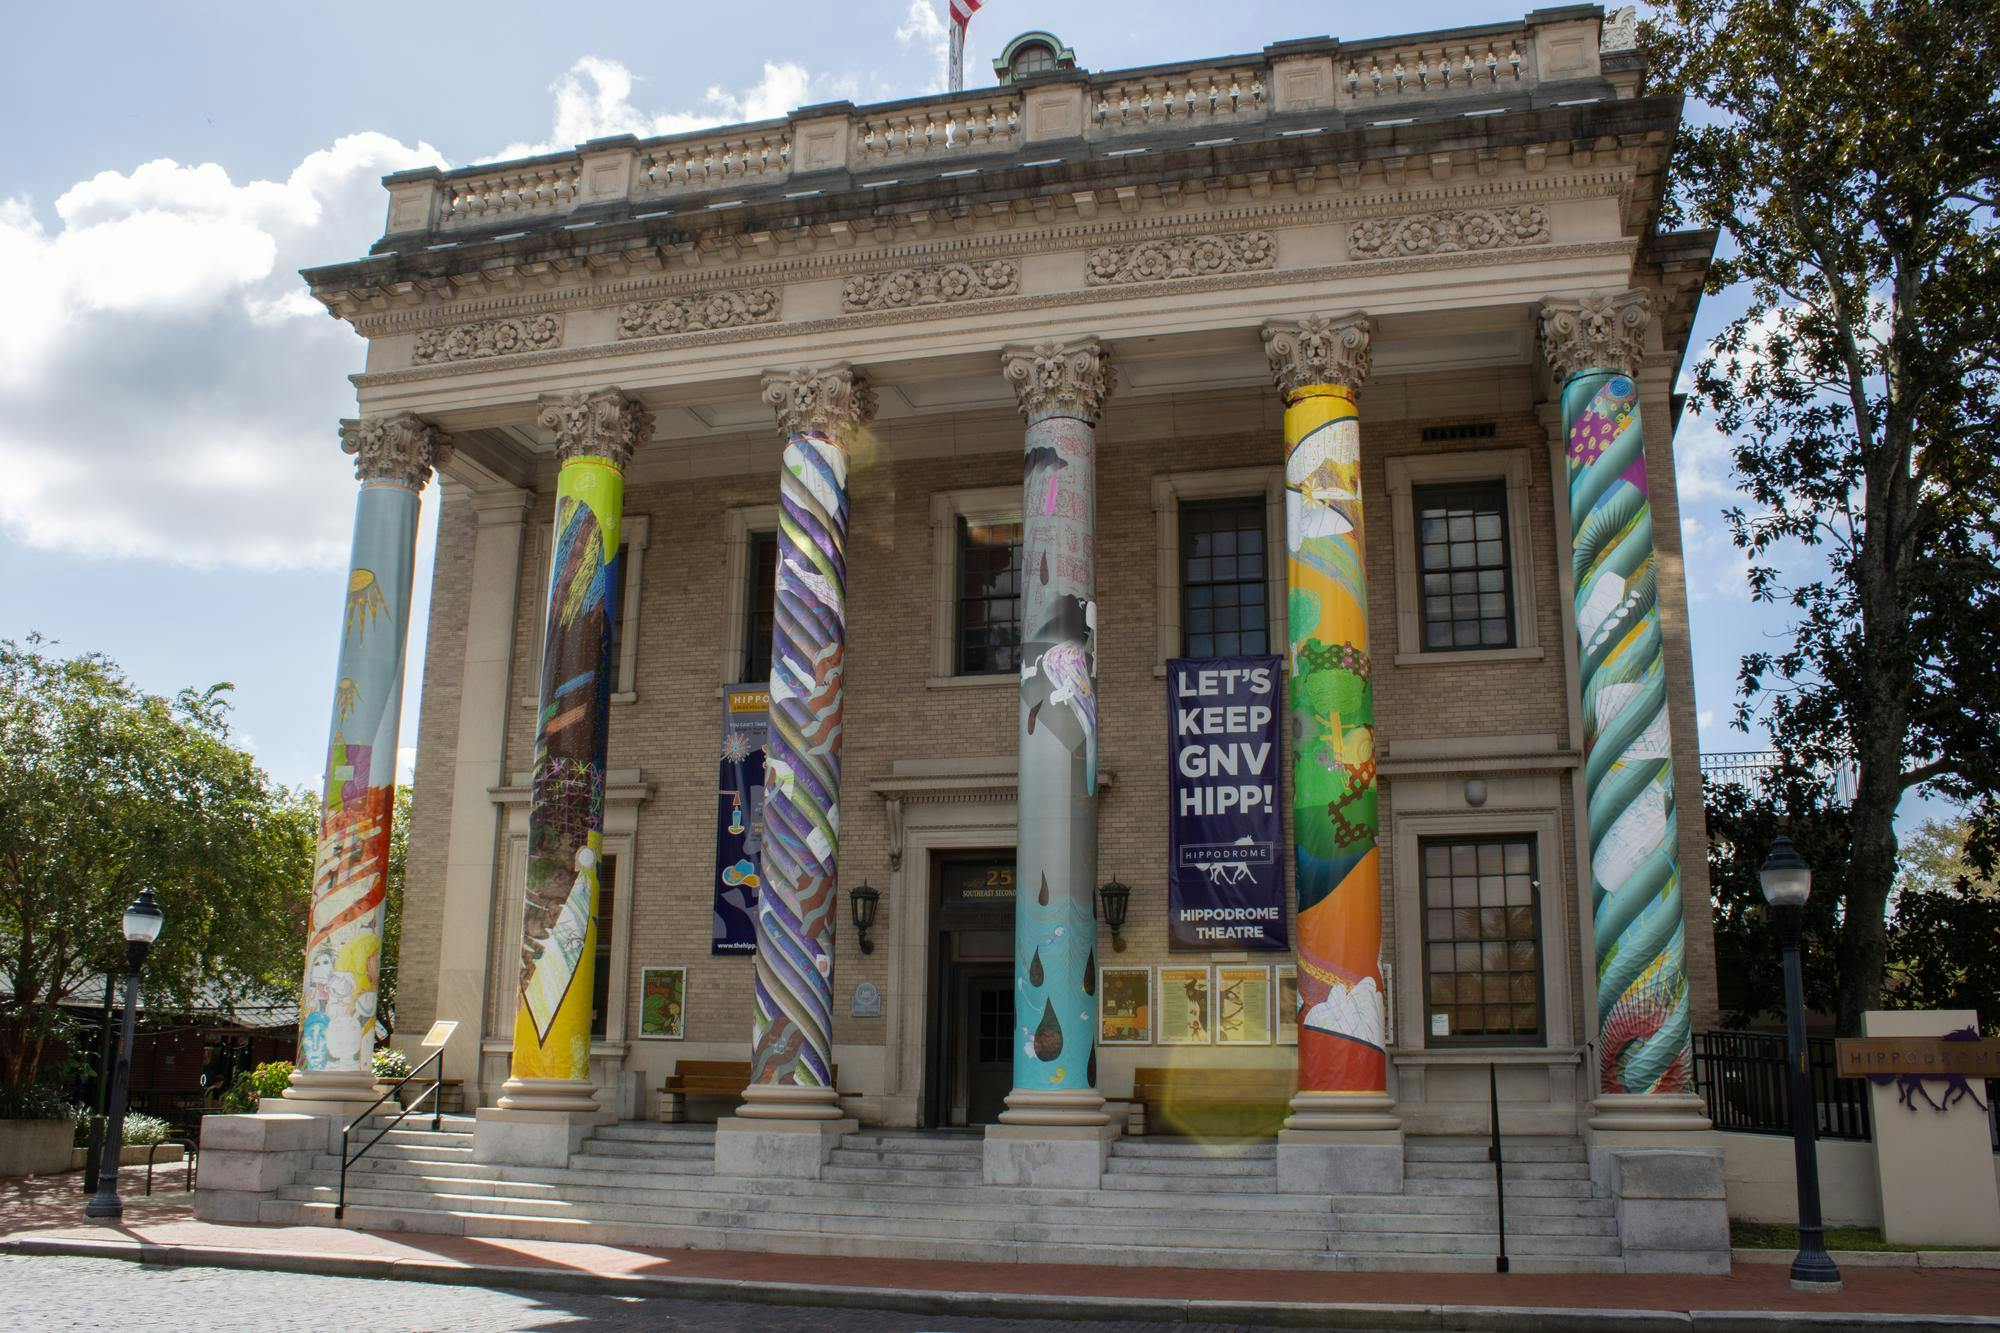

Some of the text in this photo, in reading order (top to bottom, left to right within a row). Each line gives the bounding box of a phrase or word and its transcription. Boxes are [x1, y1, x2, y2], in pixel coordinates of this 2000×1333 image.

[1178, 668, 1272, 697] LET'S
[734, 695, 769, 704] HIPPO
[1178, 705, 1272, 736] KEEP
[1178, 743, 1272, 778] GNV
[1180, 785, 1273, 817] HIPP!
[1185, 849, 1267, 860] HIPPODROME
[986, 870, 1012, 886] 25
[962, 889, 994, 897] SOUTHEAST
[1180, 907, 1279, 922] HIPPODROME
[1196, 925, 1264, 940] THEATRE
